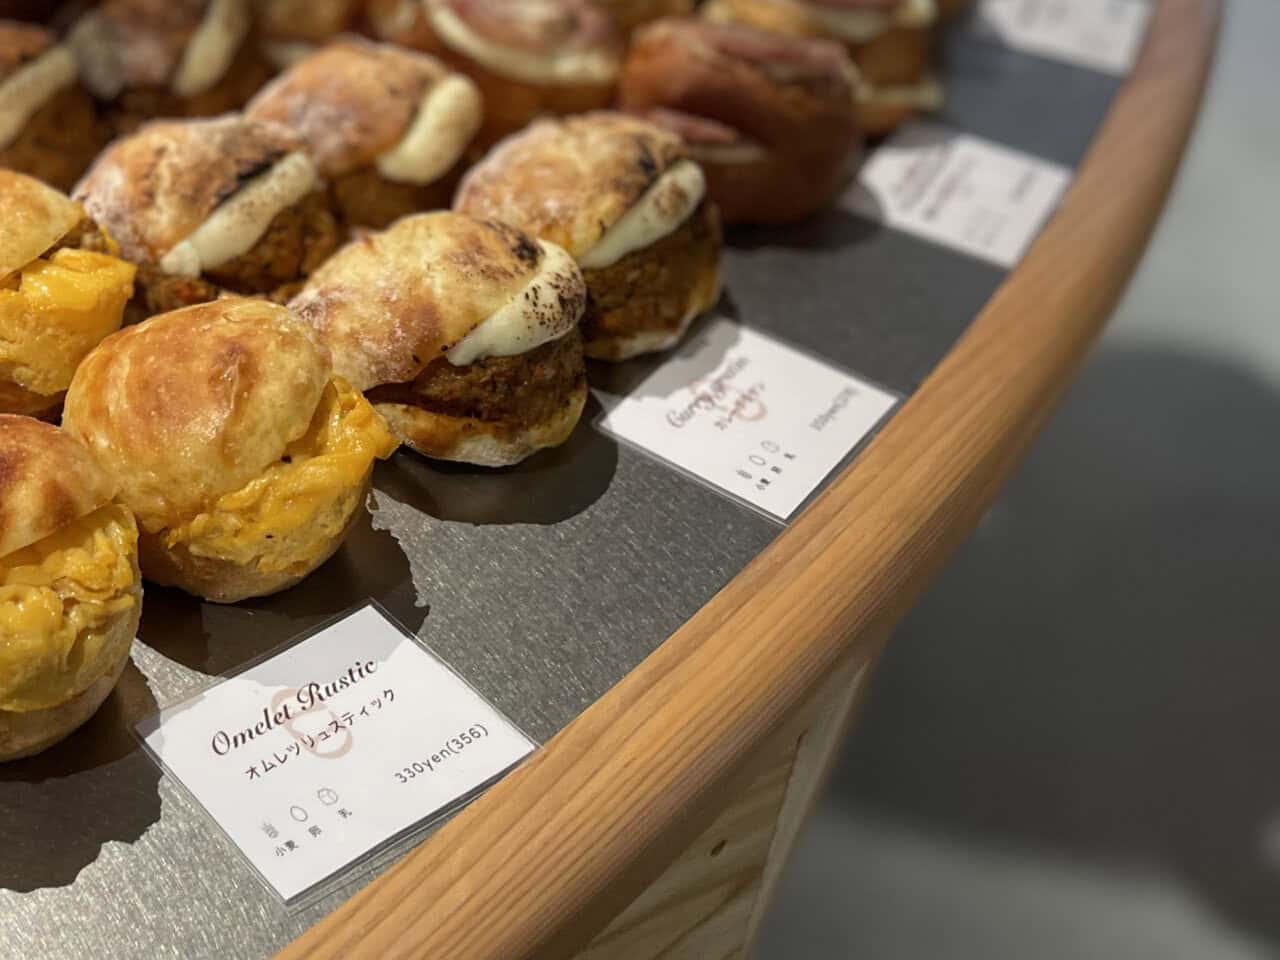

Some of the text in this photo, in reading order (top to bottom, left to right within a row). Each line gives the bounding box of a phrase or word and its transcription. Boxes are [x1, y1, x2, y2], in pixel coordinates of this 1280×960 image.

[211, 660, 378, 756] Omelet Rustic
[245, 689, 396, 780] オムレツリュスティック
[394, 723, 490, 785] 330yen(356)
